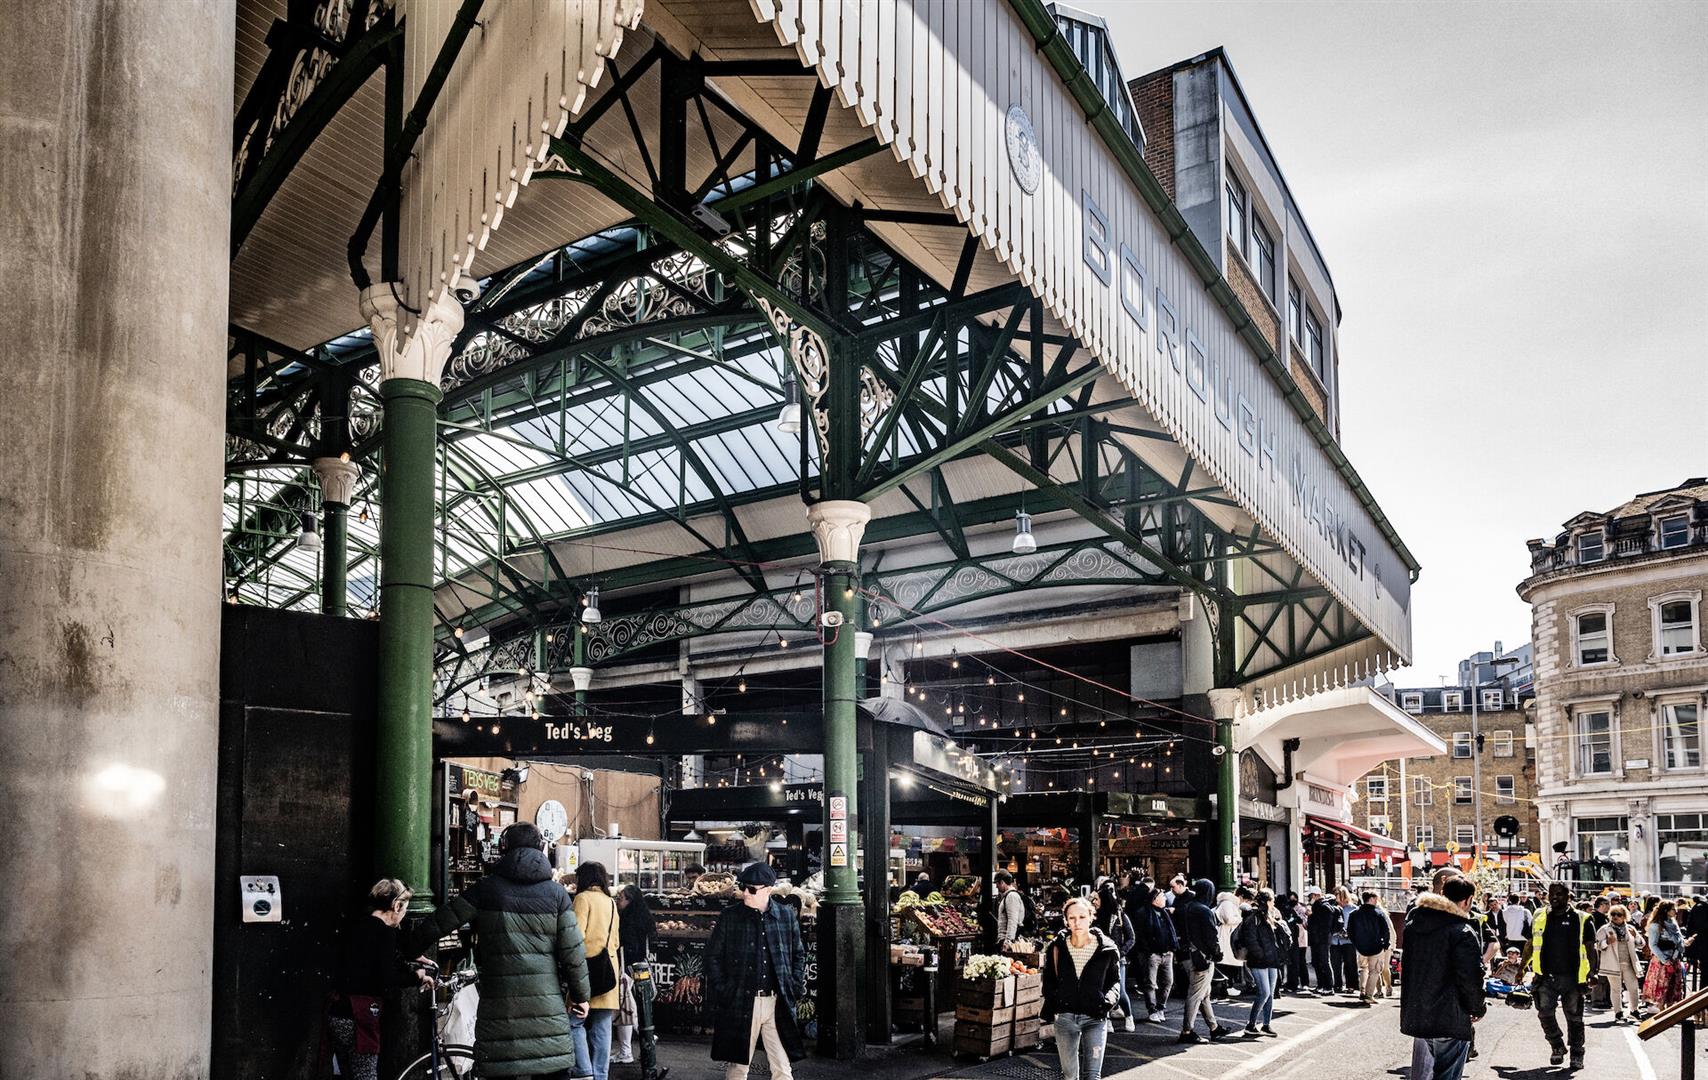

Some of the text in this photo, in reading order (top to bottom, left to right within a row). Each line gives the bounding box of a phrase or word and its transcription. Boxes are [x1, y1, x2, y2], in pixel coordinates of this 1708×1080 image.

[1082, 188, 1366, 581] BOROUGH MARKET
[545, 722, 581, 740] Ted's
[785, 788, 823, 801] Ted's Veg
[1253, 801, 1275, 821] RAYA
